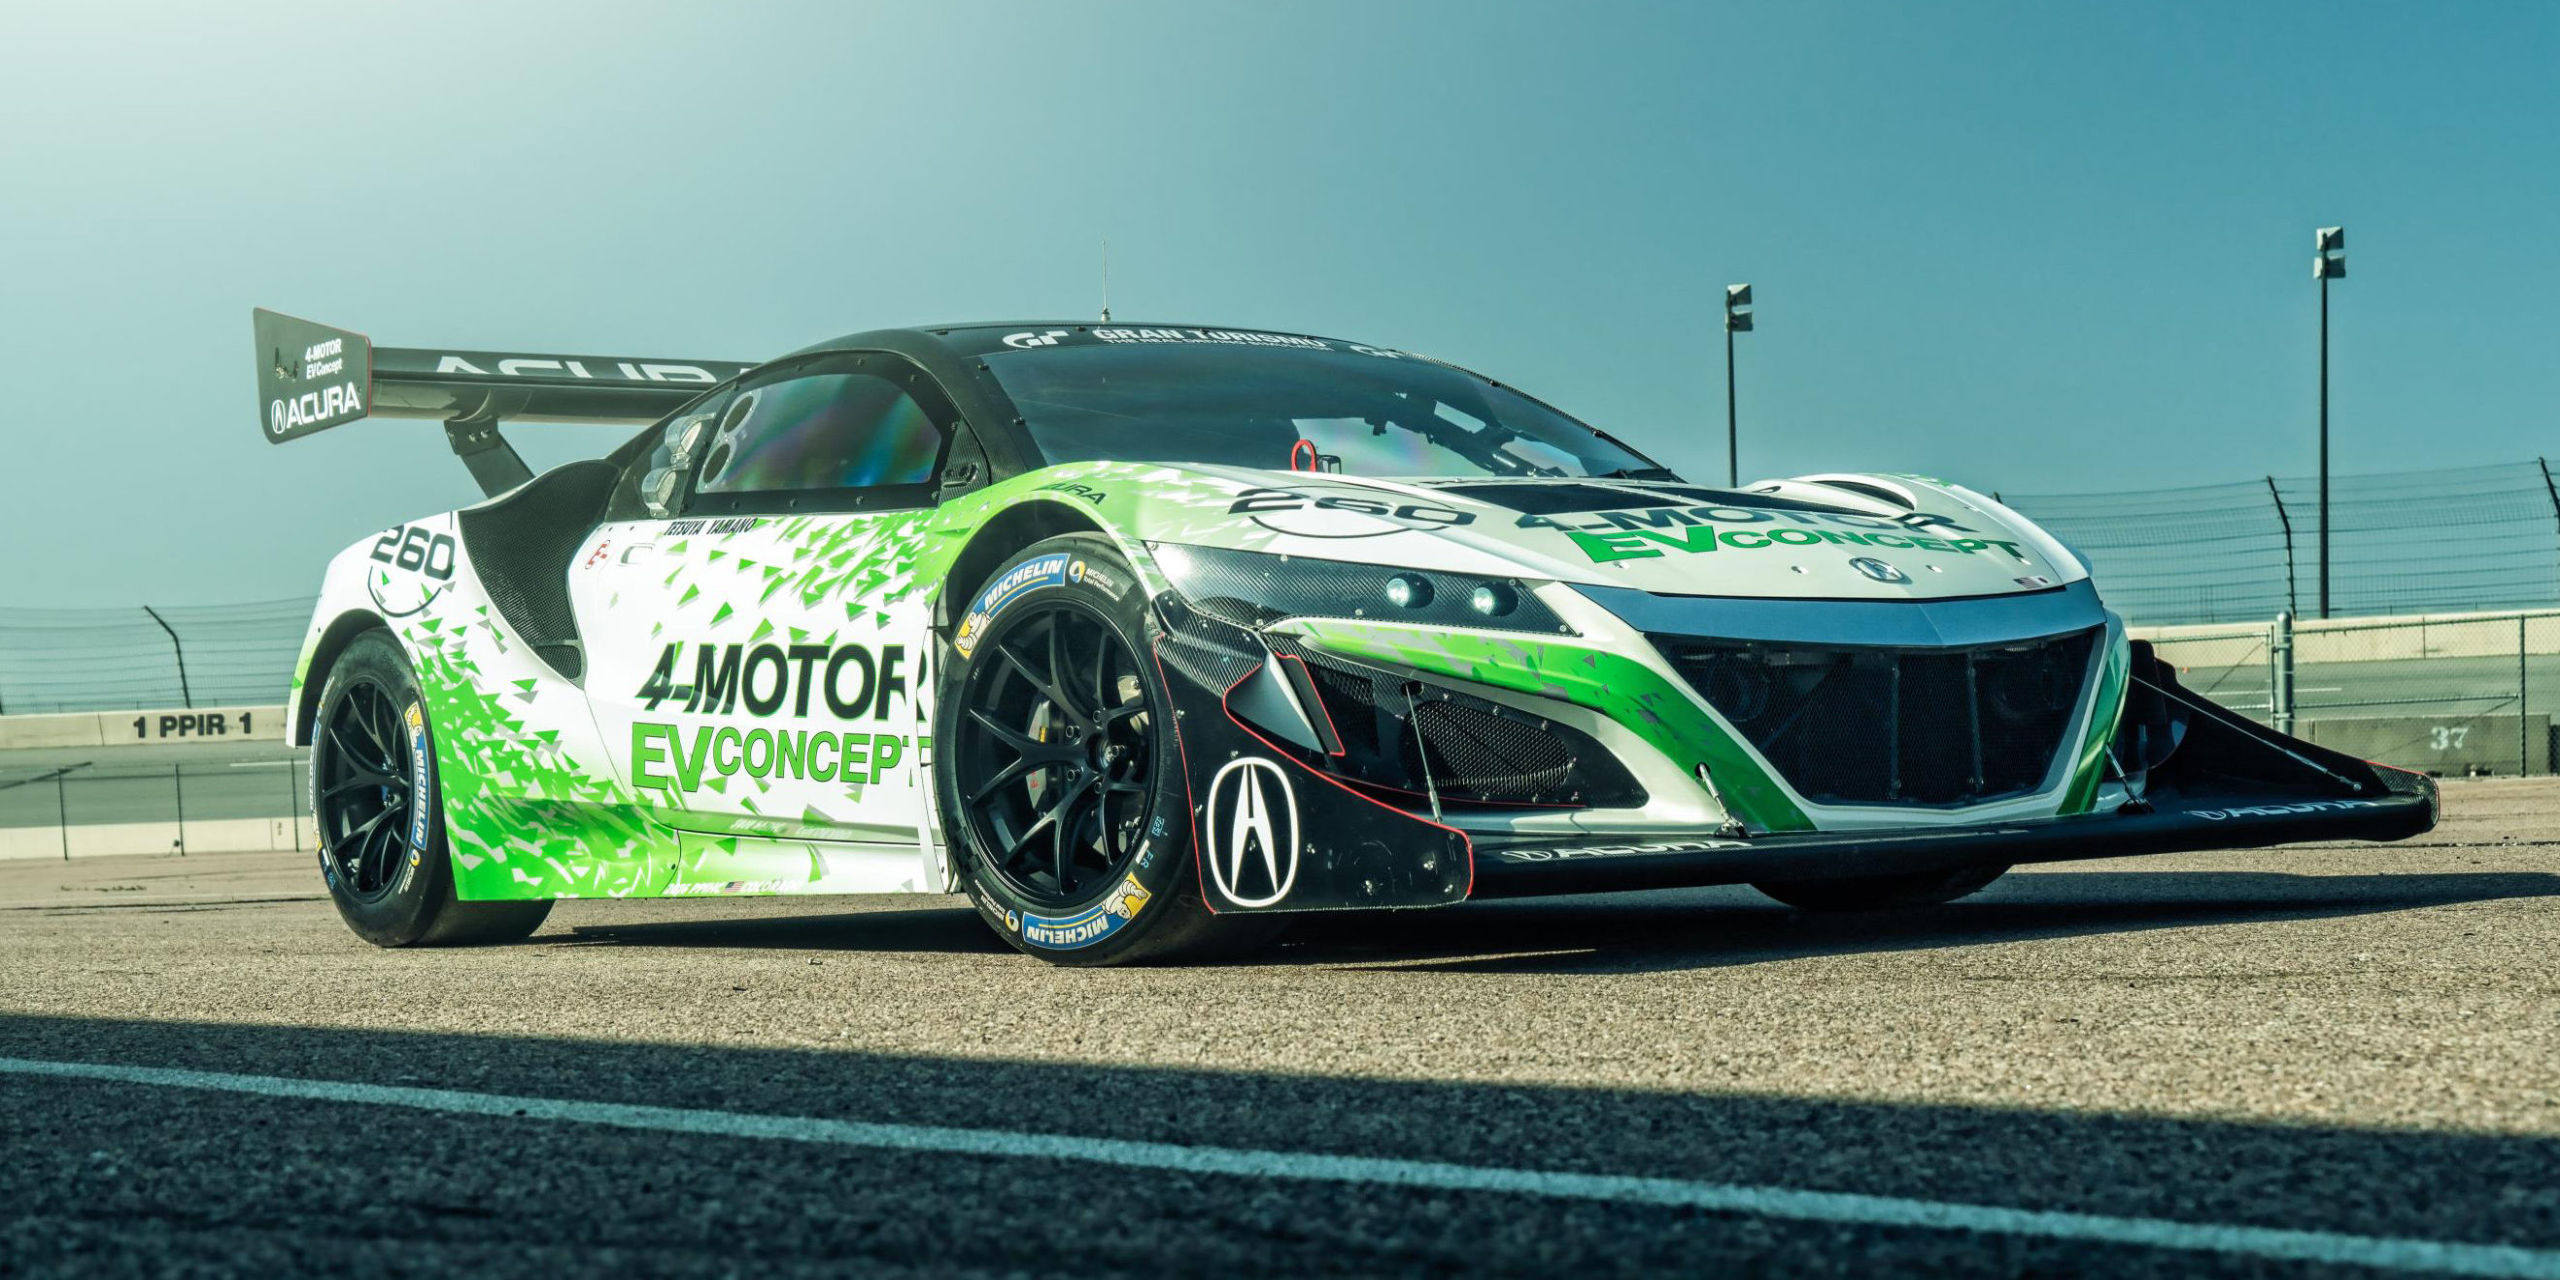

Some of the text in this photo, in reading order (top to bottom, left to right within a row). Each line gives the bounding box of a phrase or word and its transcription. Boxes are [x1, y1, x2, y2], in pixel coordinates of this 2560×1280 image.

[305, 338, 342, 362] 4-MOTOR
[1092, 329, 1185, 339] GRAN
[1186, 330, 1327, 348] TURISMO
[306, 358, 343, 380] EV Concept
[437, 355, 753, 383] ACUR
[286, 382, 361, 429] ACURA
[1032, 482, 1107, 506] URA
[1228, 488, 1478, 526] 260
[664, 517, 758, 536] TETSUYA YAMANO
[1515, 506, 1980, 533] 4-MOTOR
[369, 524, 456, 581] 260
[1565, 526, 2025, 563] EV CONCEPT
[984, 559, 1064, 611] MICHELIN
[1085, 567, 1115, 588] MICHELIN
[635, 643, 927, 723] 4-MOTOR
[133, 712, 252, 738] 1 PPIR 1
[2430, 726, 2469, 750] 37
[631, 721, 715, 792] EV
[414, 748, 426, 843] MICHELIN
[1553, 840, 1753, 858] ACURA
[1026, 914, 1110, 944] MICHELIN
